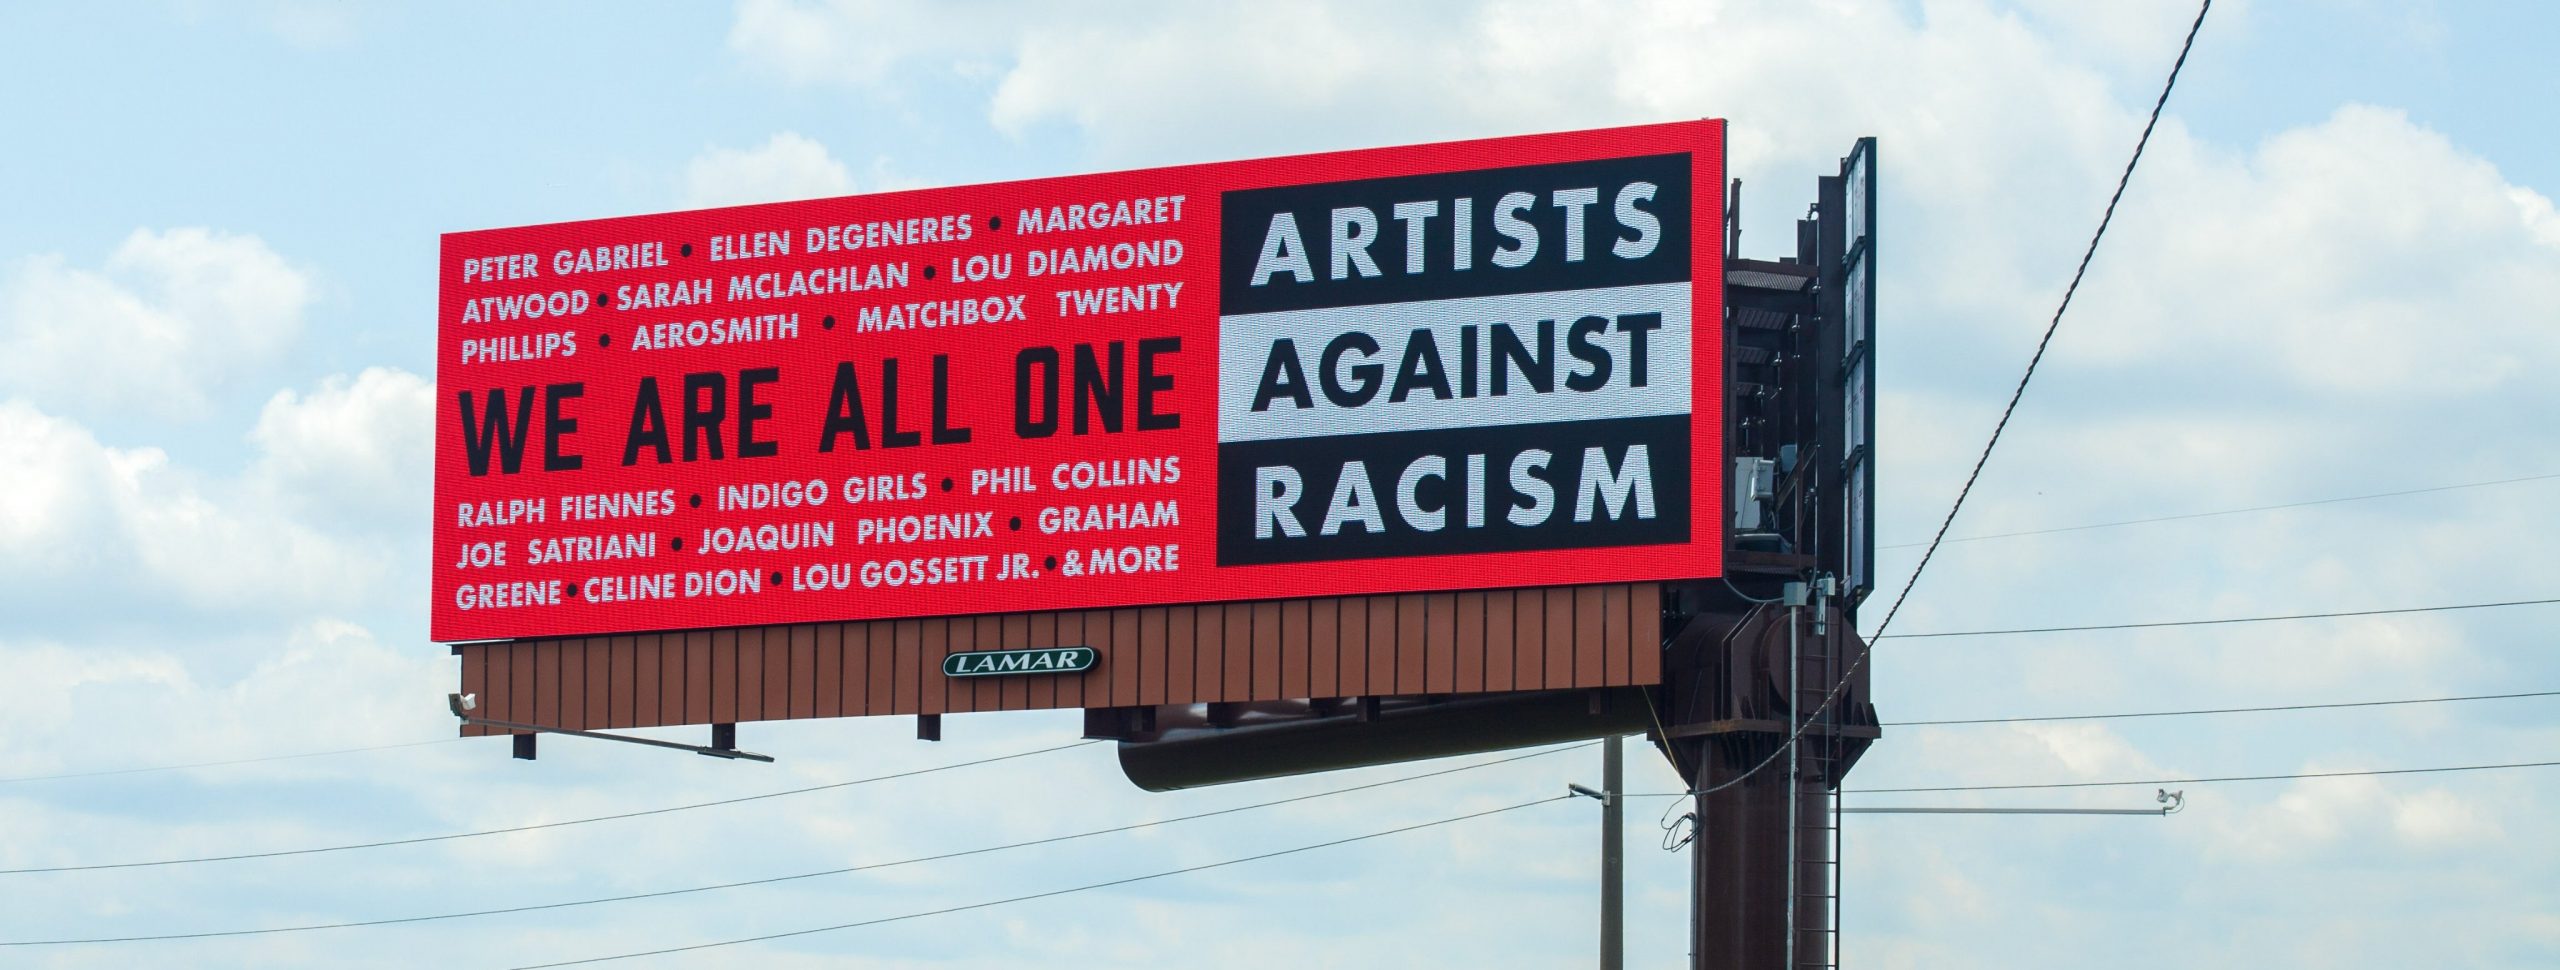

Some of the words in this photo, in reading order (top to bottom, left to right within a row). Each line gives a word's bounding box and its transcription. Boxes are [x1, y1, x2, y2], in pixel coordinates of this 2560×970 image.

[464, 254, 538, 283] PETER
[554, 242, 668, 274] GABRIEL
[711, 231, 789, 261] ELLEN
[808, 215, 972, 252] DEGENERES
[1018, 195, 1185, 234] MARGARET
[1251, 182, 1660, 285] ARTISTS
[462, 290, 589, 323] ATWOOD
[617, 279, 712, 310] SARAH
[728, 262, 908, 301] MCLACHLAN
[952, 254, 1011, 282] LOU
[1029, 240, 1183, 276] DIAMOND
[463, 332, 576, 364] PHILLIPS
[632, 314, 798, 350] AEROSMITH
[858, 295, 1025, 332] MATCHBOX
[1056, 282, 1183, 316] TWENTY
[1251, 312, 1661, 412] AGAINST
[459, 383, 583, 476] WE
[623, 368, 778, 466] ARE
[820, 355, 971, 452] ALL
[1015, 337, 1181, 439] ONE
[459, 499, 544, 527] RALPH
[562, 489, 675, 520] FIENNES
[719, 480, 828, 510] INDIGO
[844, 473, 926, 503] GIRLS
[972, 467, 1036, 494] PHIL
[1052, 456, 1180, 490] COLLINS
[1256, 445, 1656, 539] RACISM
[456, 542, 505, 568] JOE
[528, 533, 655, 564] SATRIANI
[699, 521, 833, 554] JOAQUIN
[858, 512, 993, 544] PHOENIX
[1039, 500, 1179, 534] GRAHAM
[457, 581, 560, 610] GREENE
[584, 574, 675, 603] CELINE
[685, 569, 760, 596] DION
[793, 564, 850, 590] LOU
[861, 556, 988, 587] GOSSETT
[996, 554, 1039, 580] JR.
[955, 651, 1079, 673] LAMAR
